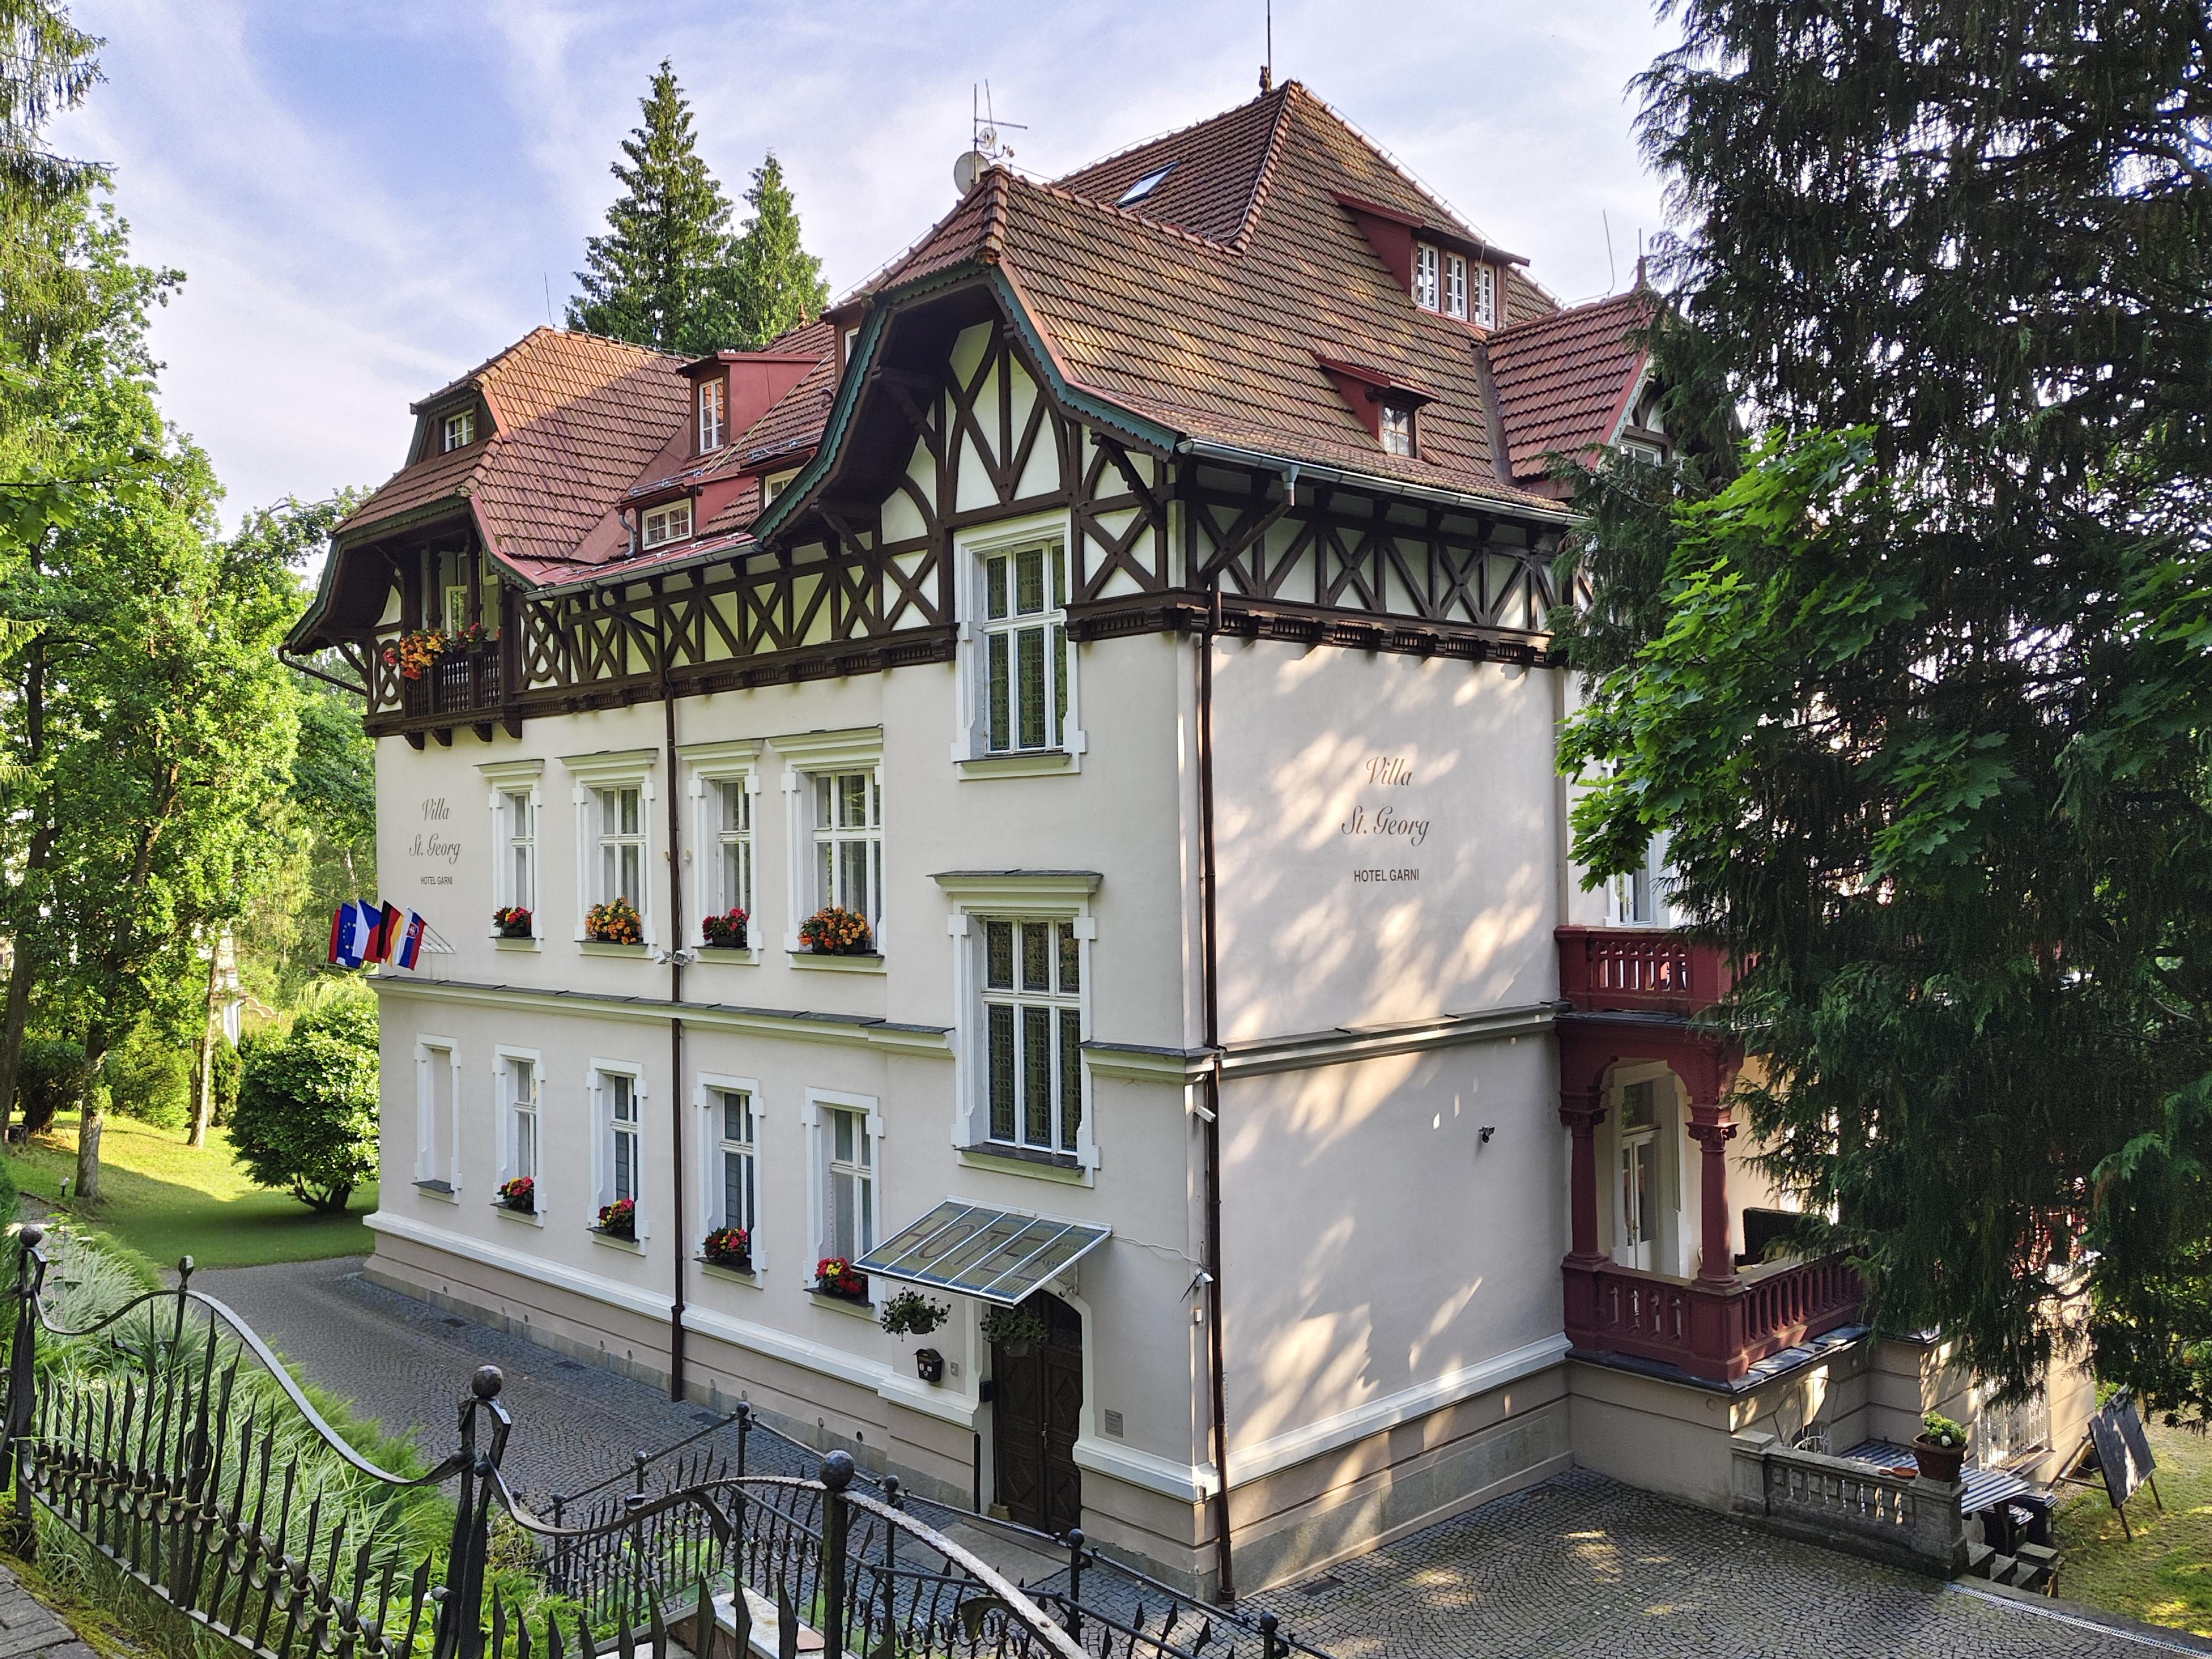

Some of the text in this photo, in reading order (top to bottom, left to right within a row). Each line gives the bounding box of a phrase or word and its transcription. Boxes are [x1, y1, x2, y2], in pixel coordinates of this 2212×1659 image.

[1366, 756, 1413, 786] Villa
[422, 797, 450, 821] Villa
[1341, 805, 1431, 847] St. Georg
[409, 833, 461, 865] St. Georg
[420, 876, 453, 885] HOTEL GARNI
[1354, 869, 1420, 882] HOTEL GARNI
[883, 1216, 1064, 1284] HOTEL
